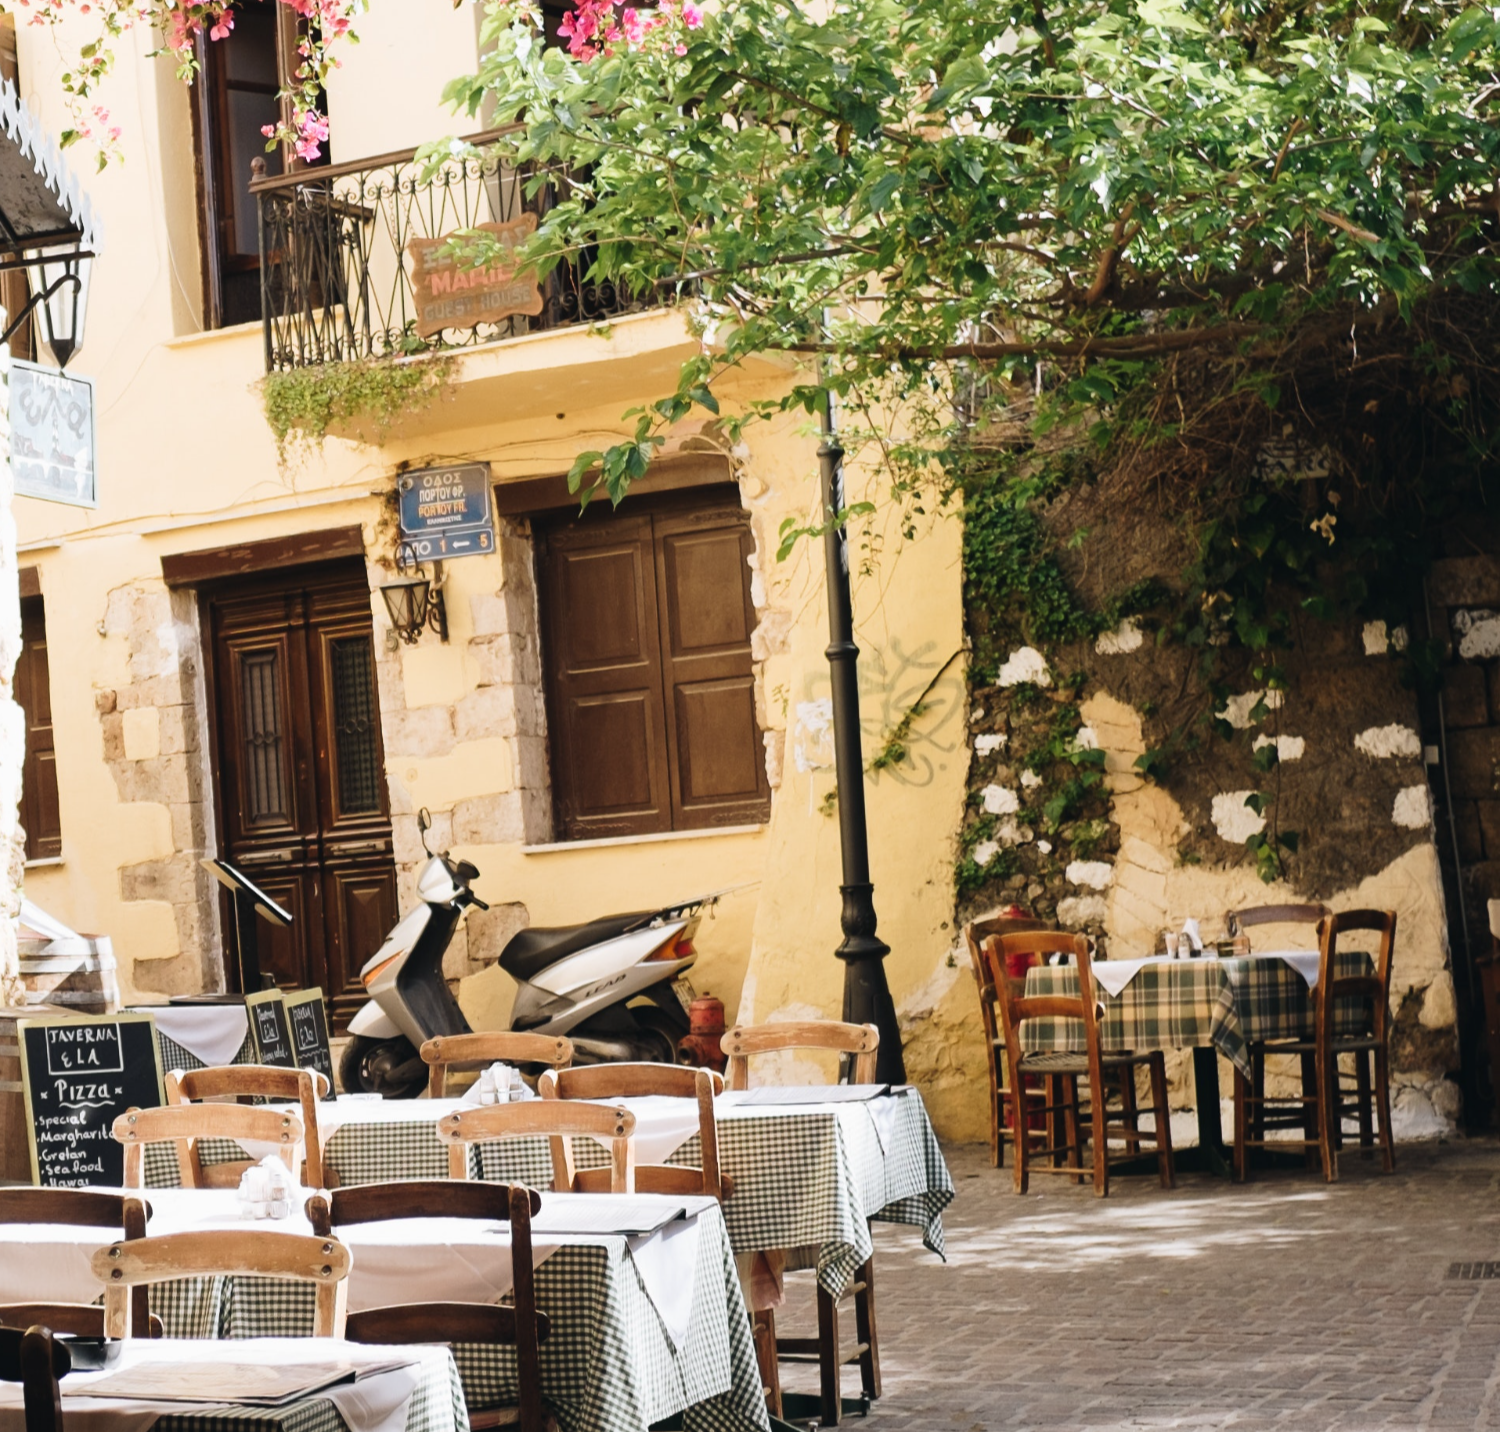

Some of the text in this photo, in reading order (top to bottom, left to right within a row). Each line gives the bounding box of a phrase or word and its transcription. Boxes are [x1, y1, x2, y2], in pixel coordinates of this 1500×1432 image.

[423, 285, 531, 321] GUEST HOUSE
[423, 473, 461, 487] ΟΔΟΣ
[419, 487, 451, 503] ΠΟΡΤΟΥ
[404, 534, 488, 557] ΑΠΟ 1 5
[585, 973, 626, 998] LEAD
[49, 1028, 117, 1044] TAVERNA
